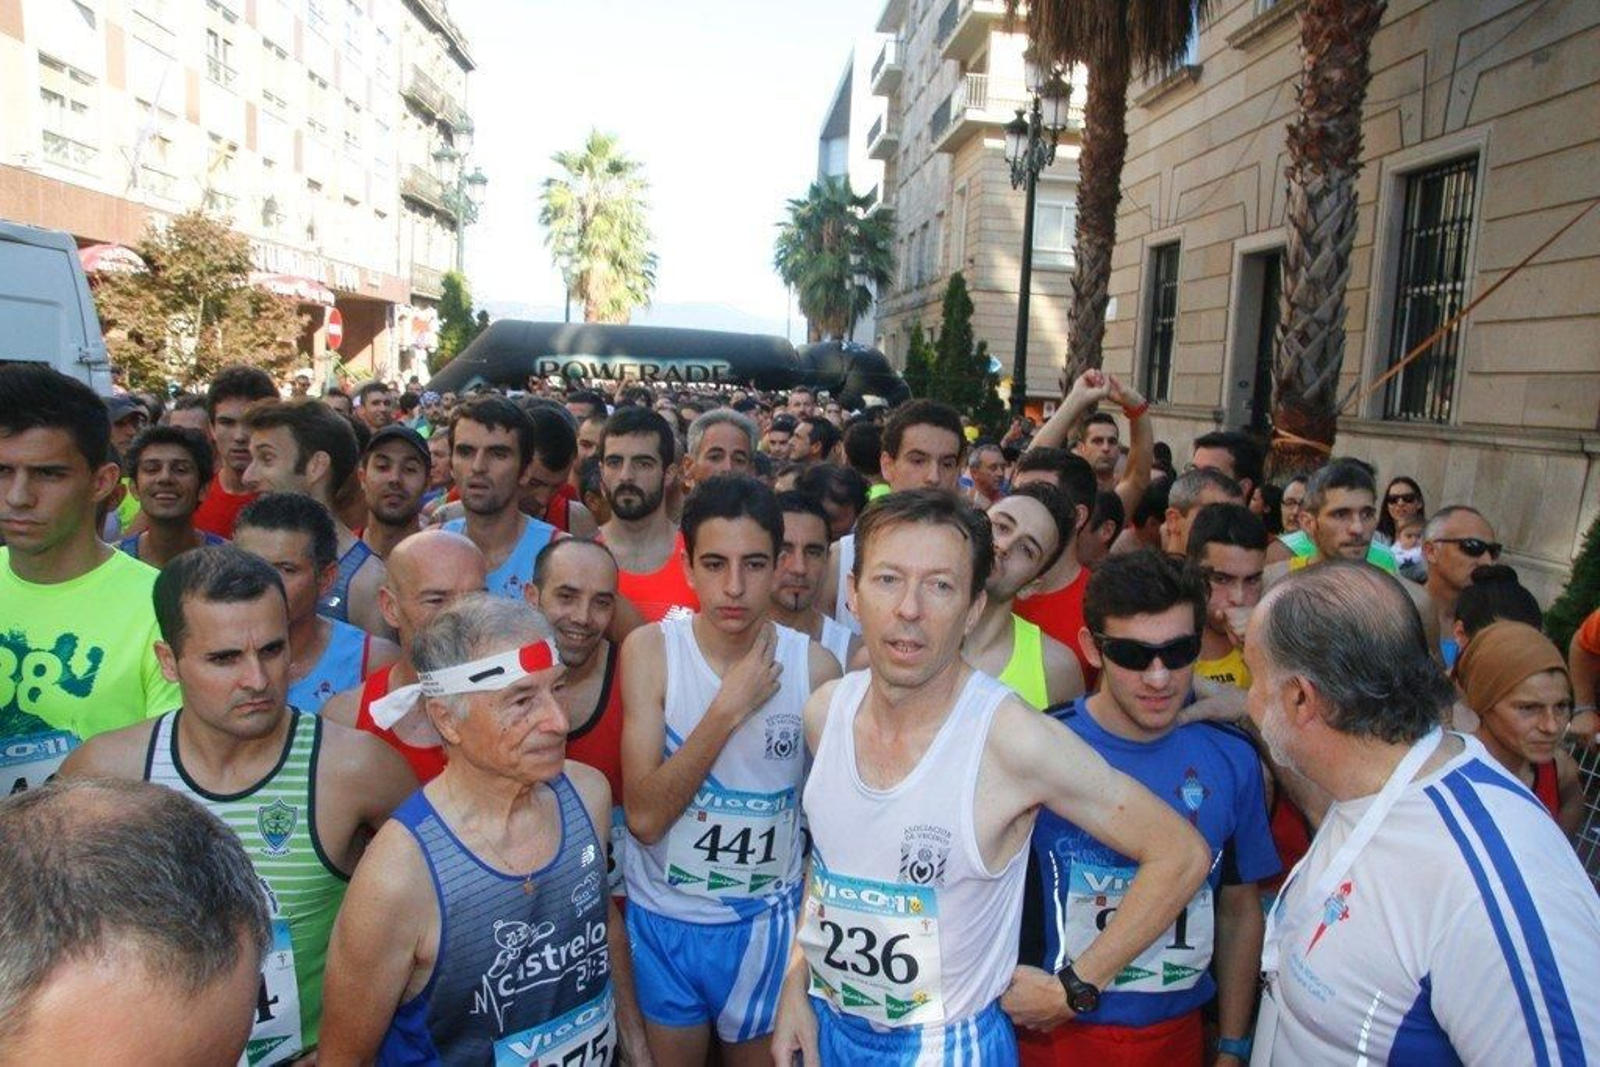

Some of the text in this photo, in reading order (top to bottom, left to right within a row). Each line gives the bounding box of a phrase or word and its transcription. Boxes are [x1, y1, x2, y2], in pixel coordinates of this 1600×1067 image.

[537, 359, 730, 382] POWERADE
[693, 824, 777, 865] 441
[820, 920, 919, 984] 236
[546, 1022, 610, 1067] 75
